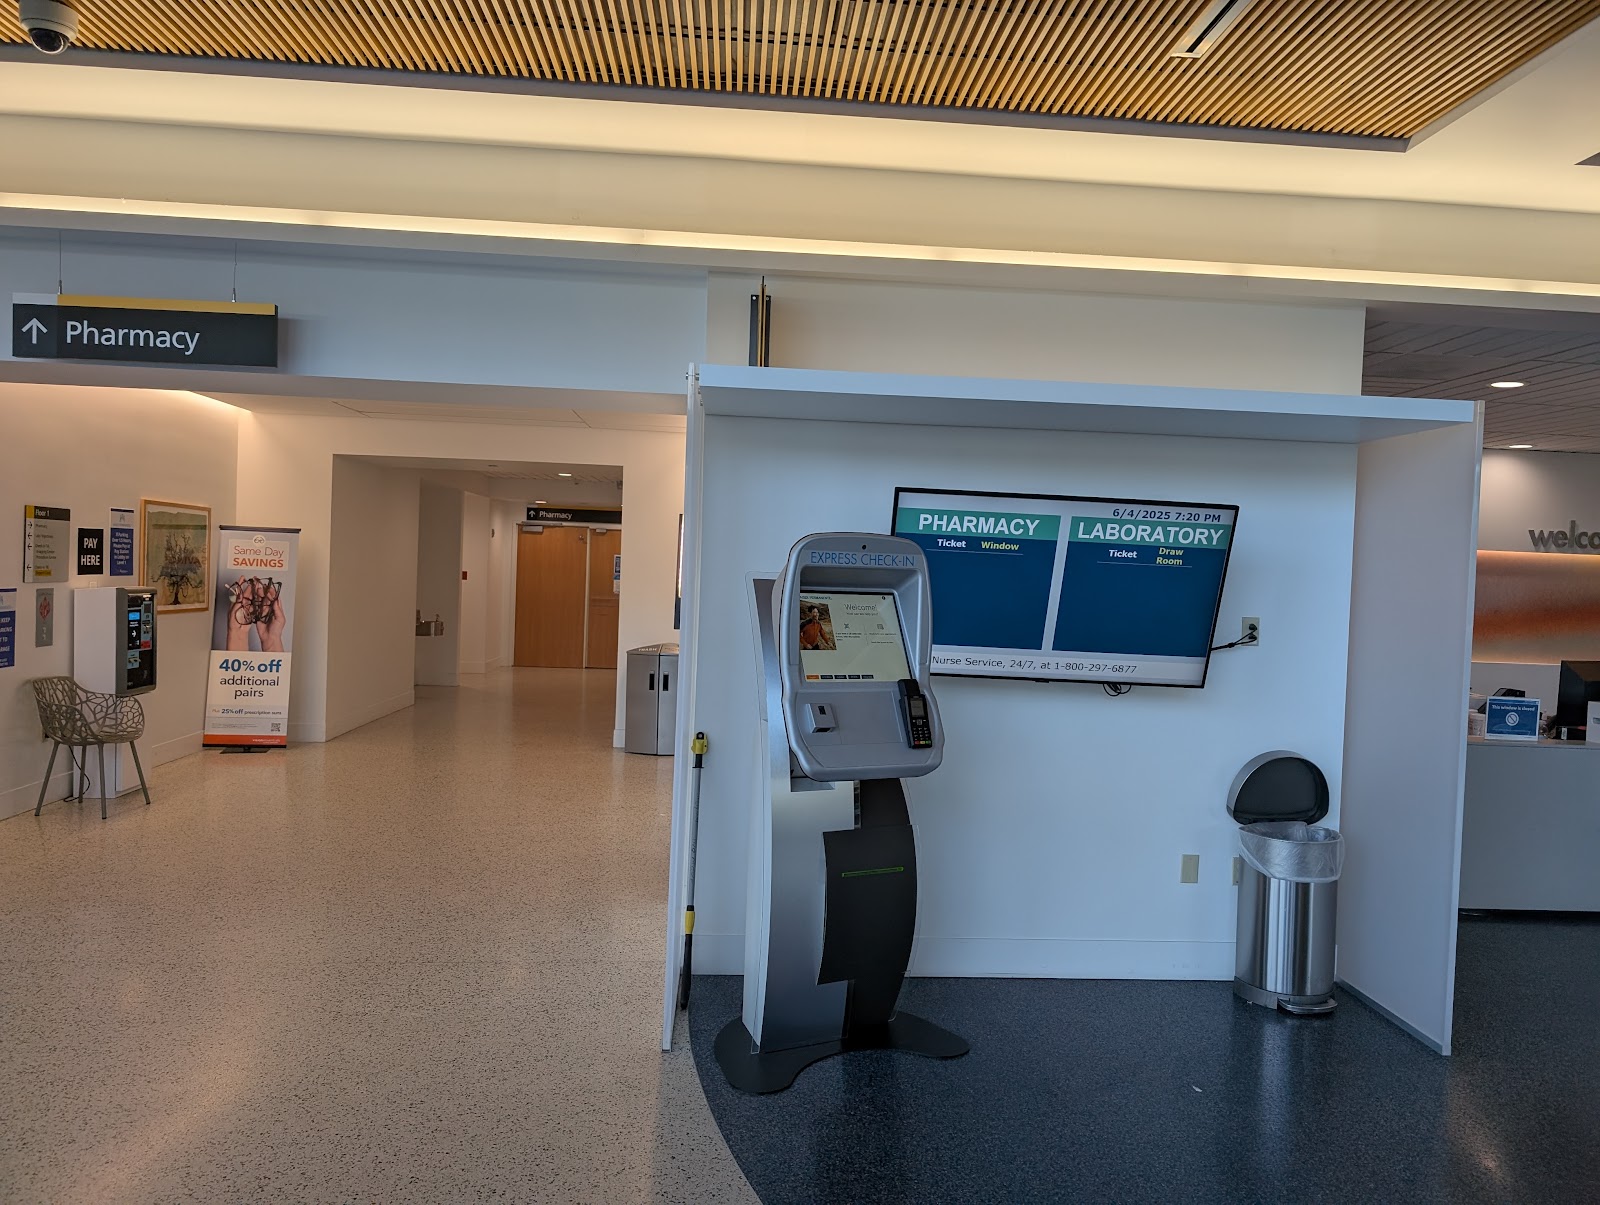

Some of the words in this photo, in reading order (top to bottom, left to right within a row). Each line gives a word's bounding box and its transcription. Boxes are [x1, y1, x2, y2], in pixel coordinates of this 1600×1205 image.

[66, 319, 200, 355] Pharmacy
[539, 511, 573, 520] Pharmacy
[1112, 508, 1170, 521] 6/4/2025
[1174, 510, 1201, 522] 7:20
[1203, 513, 1222, 523] PM
[918, 513, 1040, 536] PHARMACY
[1077, 522, 1224, 545] LABORATORY
[83, 537, 98, 549] PAY
[937, 539, 967, 549] Ticket
[981, 541, 1020, 551] Window
[233, 545, 261, 556] Same
[264, 547, 284, 558] Day
[1108, 549, 1138, 559] Ticket
[1158, 547, 1184, 556] Draw
[80, 554, 101, 566] HERE
[232, 557, 284, 568] SAVINGS
[810, 551, 858, 566] EXPRESS
[860, 553, 915, 567] CHECK-IN
[1156, 556, 1183, 566] Room
[219, 658, 255, 672] 40%
[257, 659, 282, 673] off
[932, 656, 962, 666] Nurse
[965, 657, 1006, 669] Service,
[1009, 659, 1037, 671] 24/7,
[1040, 661, 1052, 670] at
[1054, 661, 1137, 674] 1-800-297-6877
[219, 675, 280, 687] additional
[234, 687, 264, 700] pairs
